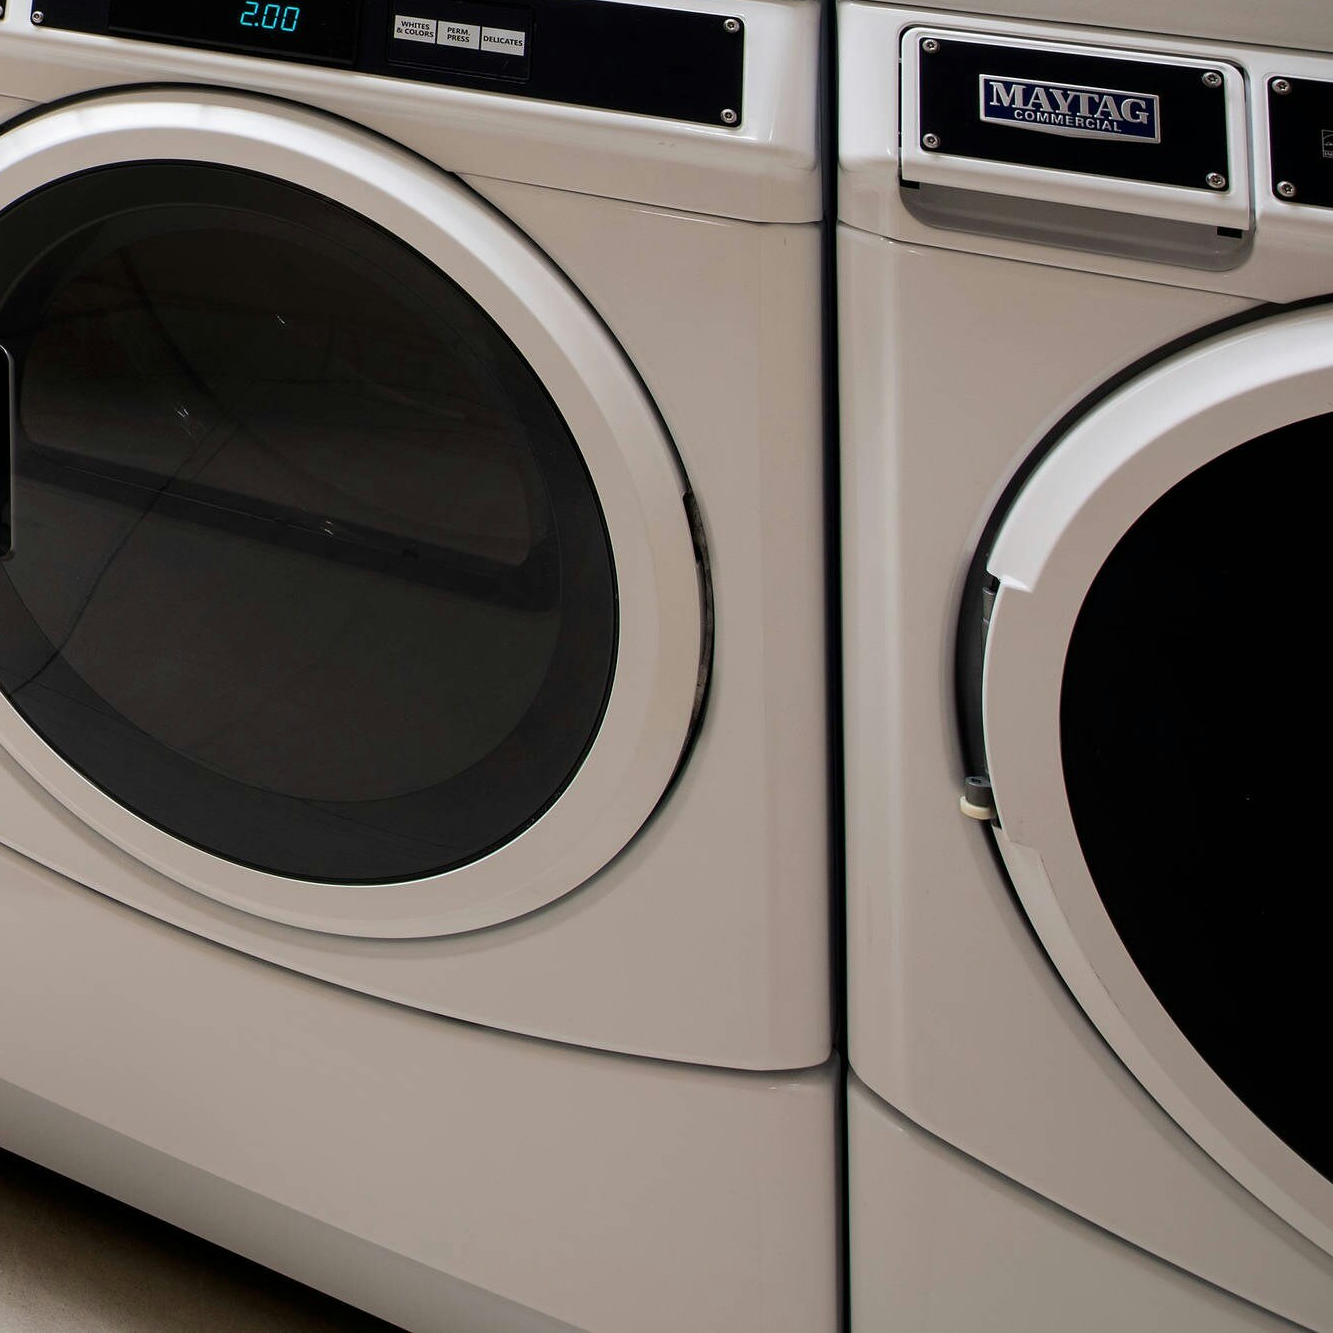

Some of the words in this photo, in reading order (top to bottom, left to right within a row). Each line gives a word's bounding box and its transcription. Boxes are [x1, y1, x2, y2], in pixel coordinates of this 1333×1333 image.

[239, 1, 300, 32] 2.00
[401, 20, 430, 30] WHITES
[404, 27, 434, 38] COLORS
[447, 26, 471, 36] PERM.
[446, 34, 470, 43] PRESS
[483, 35, 523, 47] DELICATES
[989, 81, 1150, 125] MAYTAG
[1014, 109, 1122, 133] COMMERCIAL
